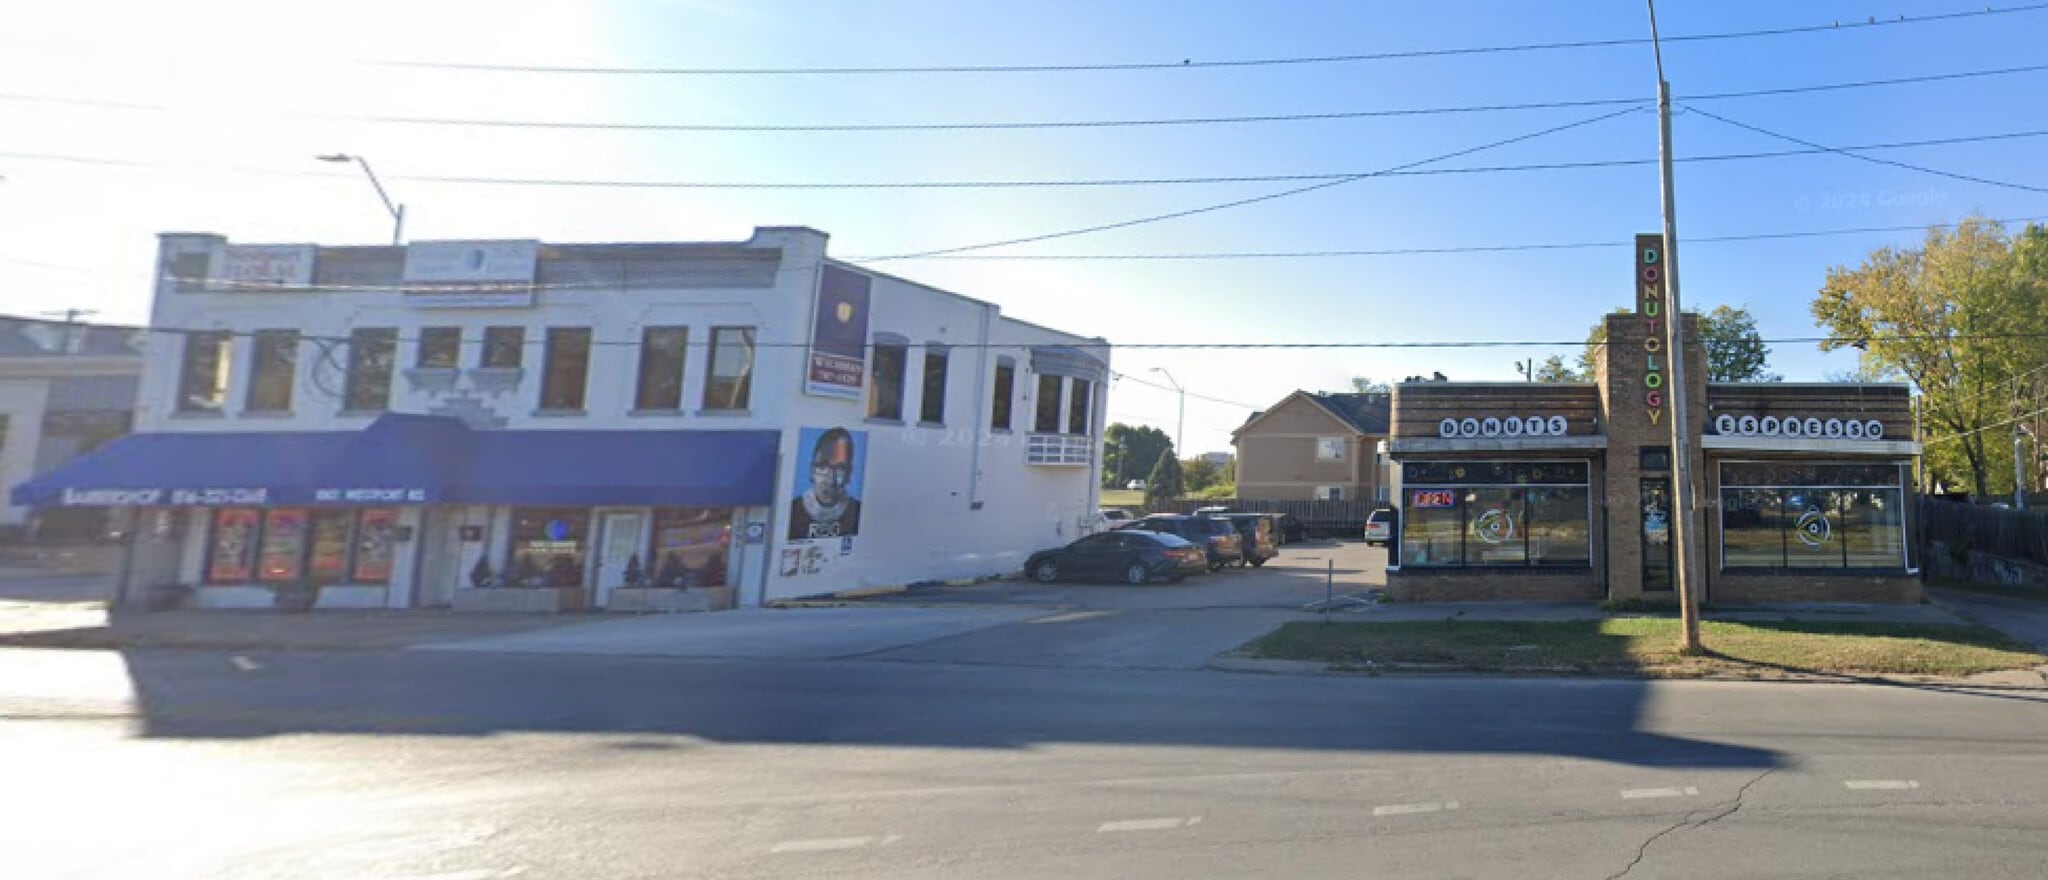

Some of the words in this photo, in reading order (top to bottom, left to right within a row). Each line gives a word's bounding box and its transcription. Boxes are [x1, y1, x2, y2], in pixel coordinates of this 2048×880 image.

[1643, 249, 1662, 426] DONUTOLOGY
[1442, 417, 1565, 437] DONUTS
[1718, 416, 1883, 438] ESPRESSO
[1416, 492, 1453, 507] OPEN
